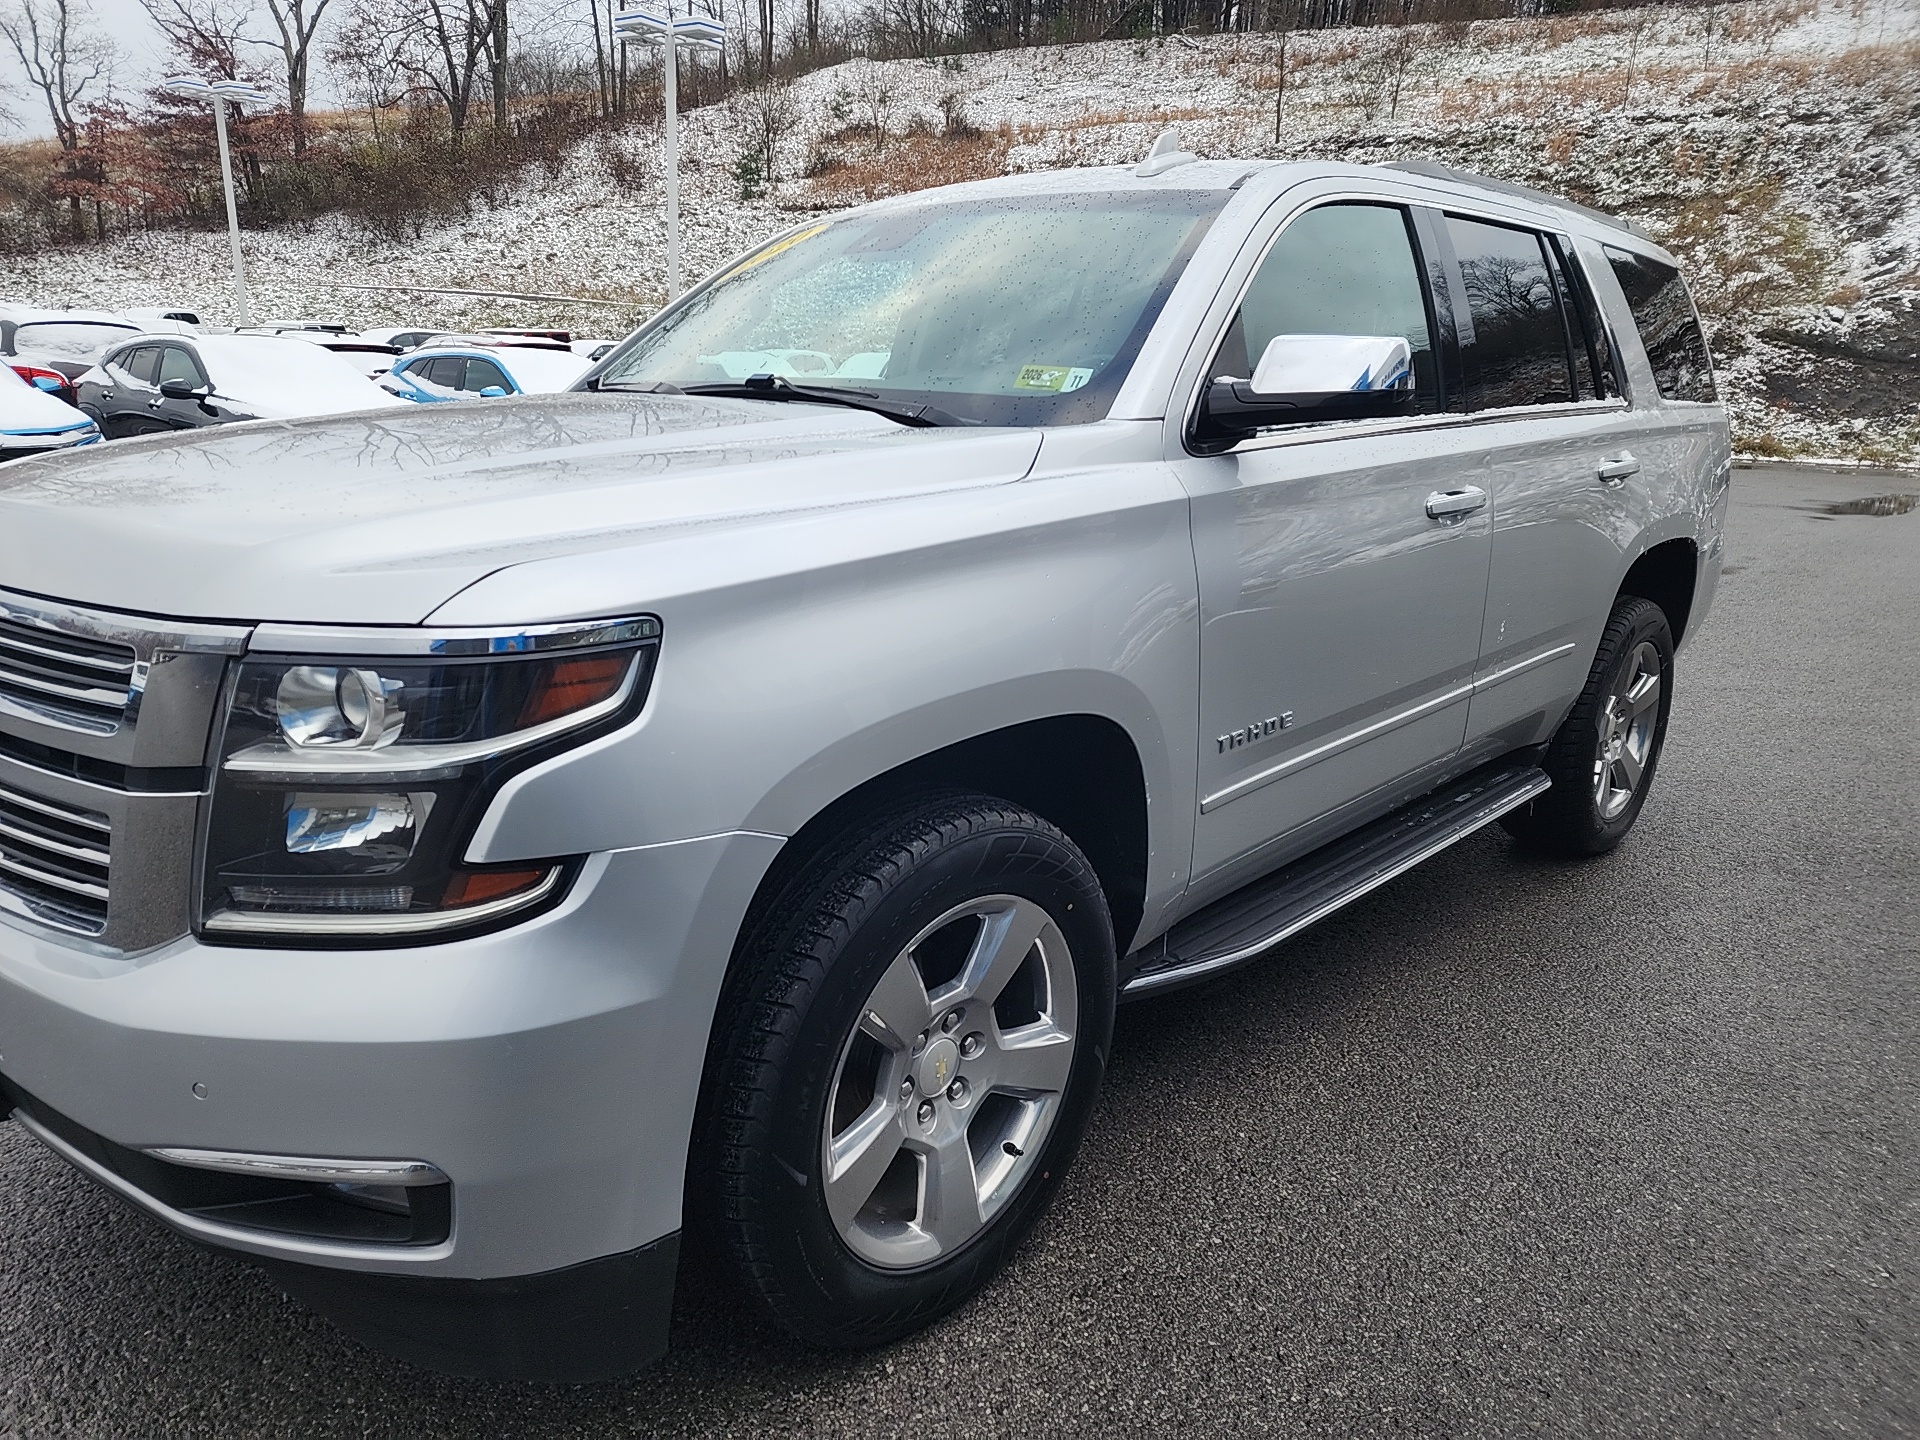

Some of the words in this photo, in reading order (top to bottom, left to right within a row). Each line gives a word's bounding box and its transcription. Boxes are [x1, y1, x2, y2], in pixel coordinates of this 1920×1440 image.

[1021, 368, 1044, 381] 2026
[1070, 375, 1083, 389] 11
[1216, 710, 1294, 754] TAHOE
